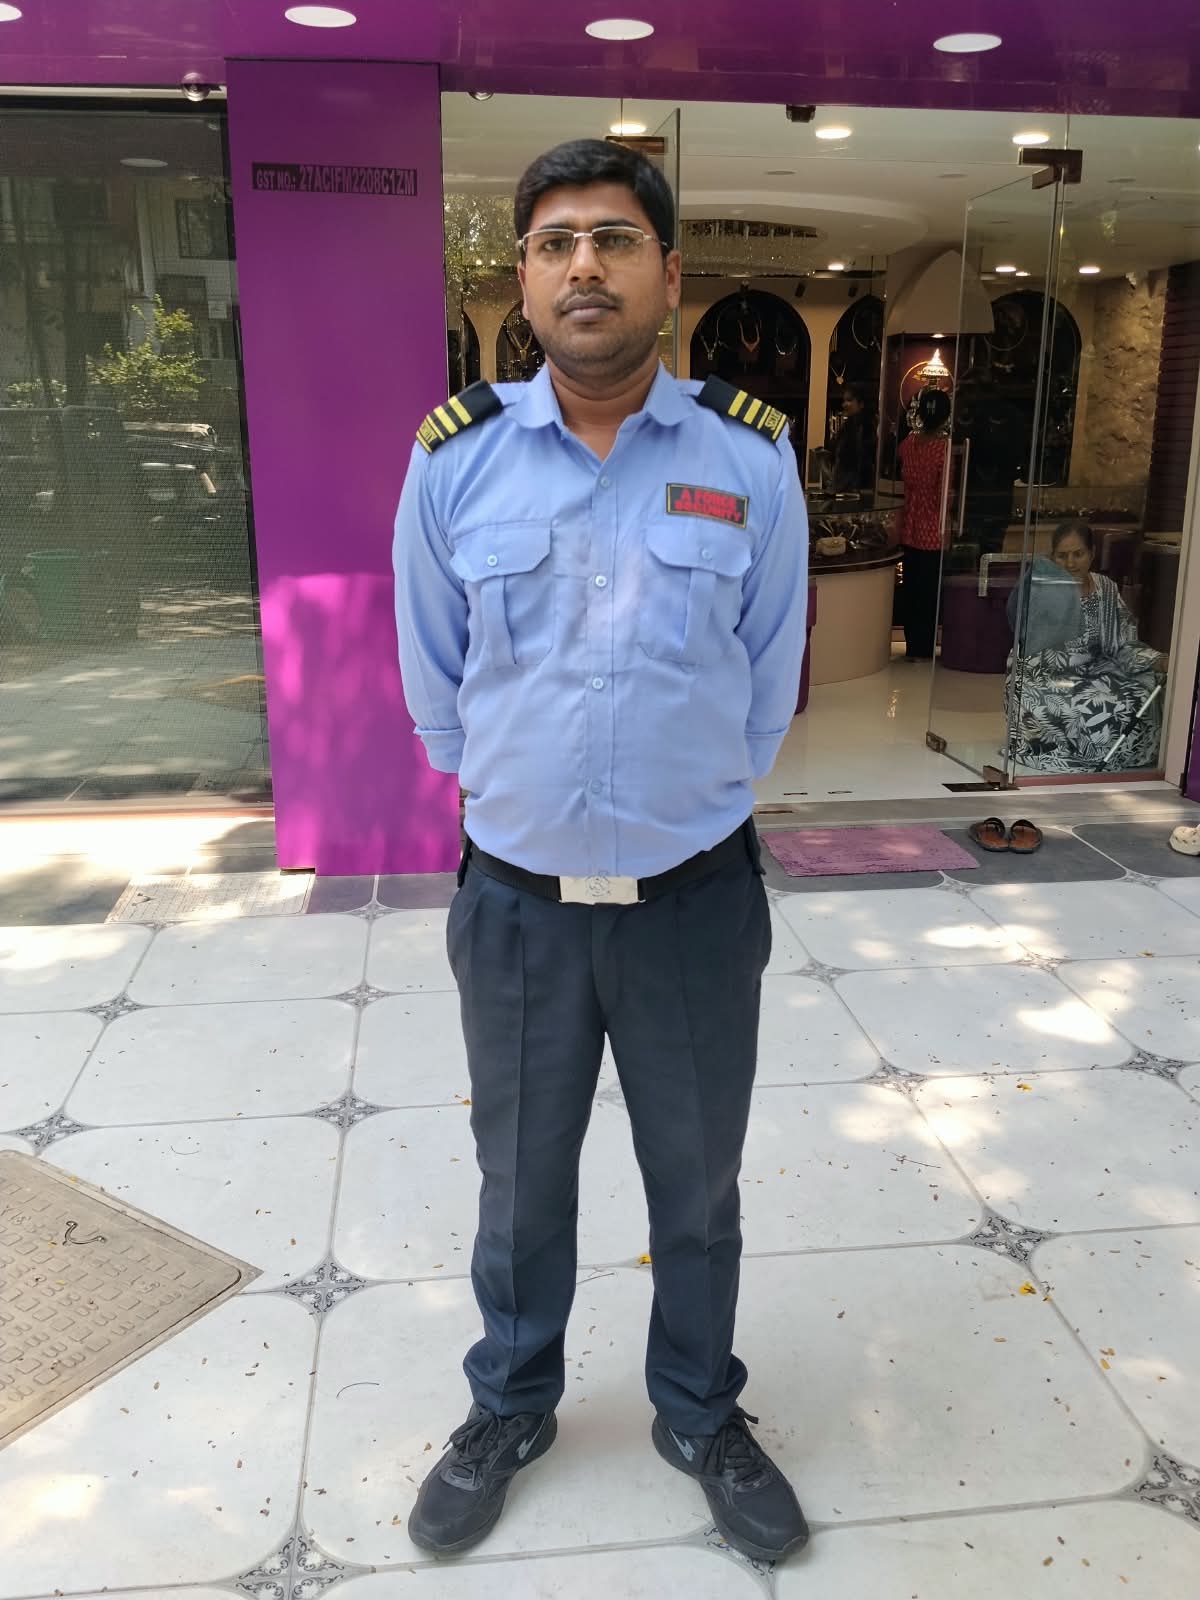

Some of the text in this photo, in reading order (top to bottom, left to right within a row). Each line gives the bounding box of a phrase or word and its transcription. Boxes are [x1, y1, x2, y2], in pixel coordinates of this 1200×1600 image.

[256, 169, 275, 189] GST
[299, 166, 415, 196] 27ACIFM2208C1ZM
[681, 488, 692, 502] A
